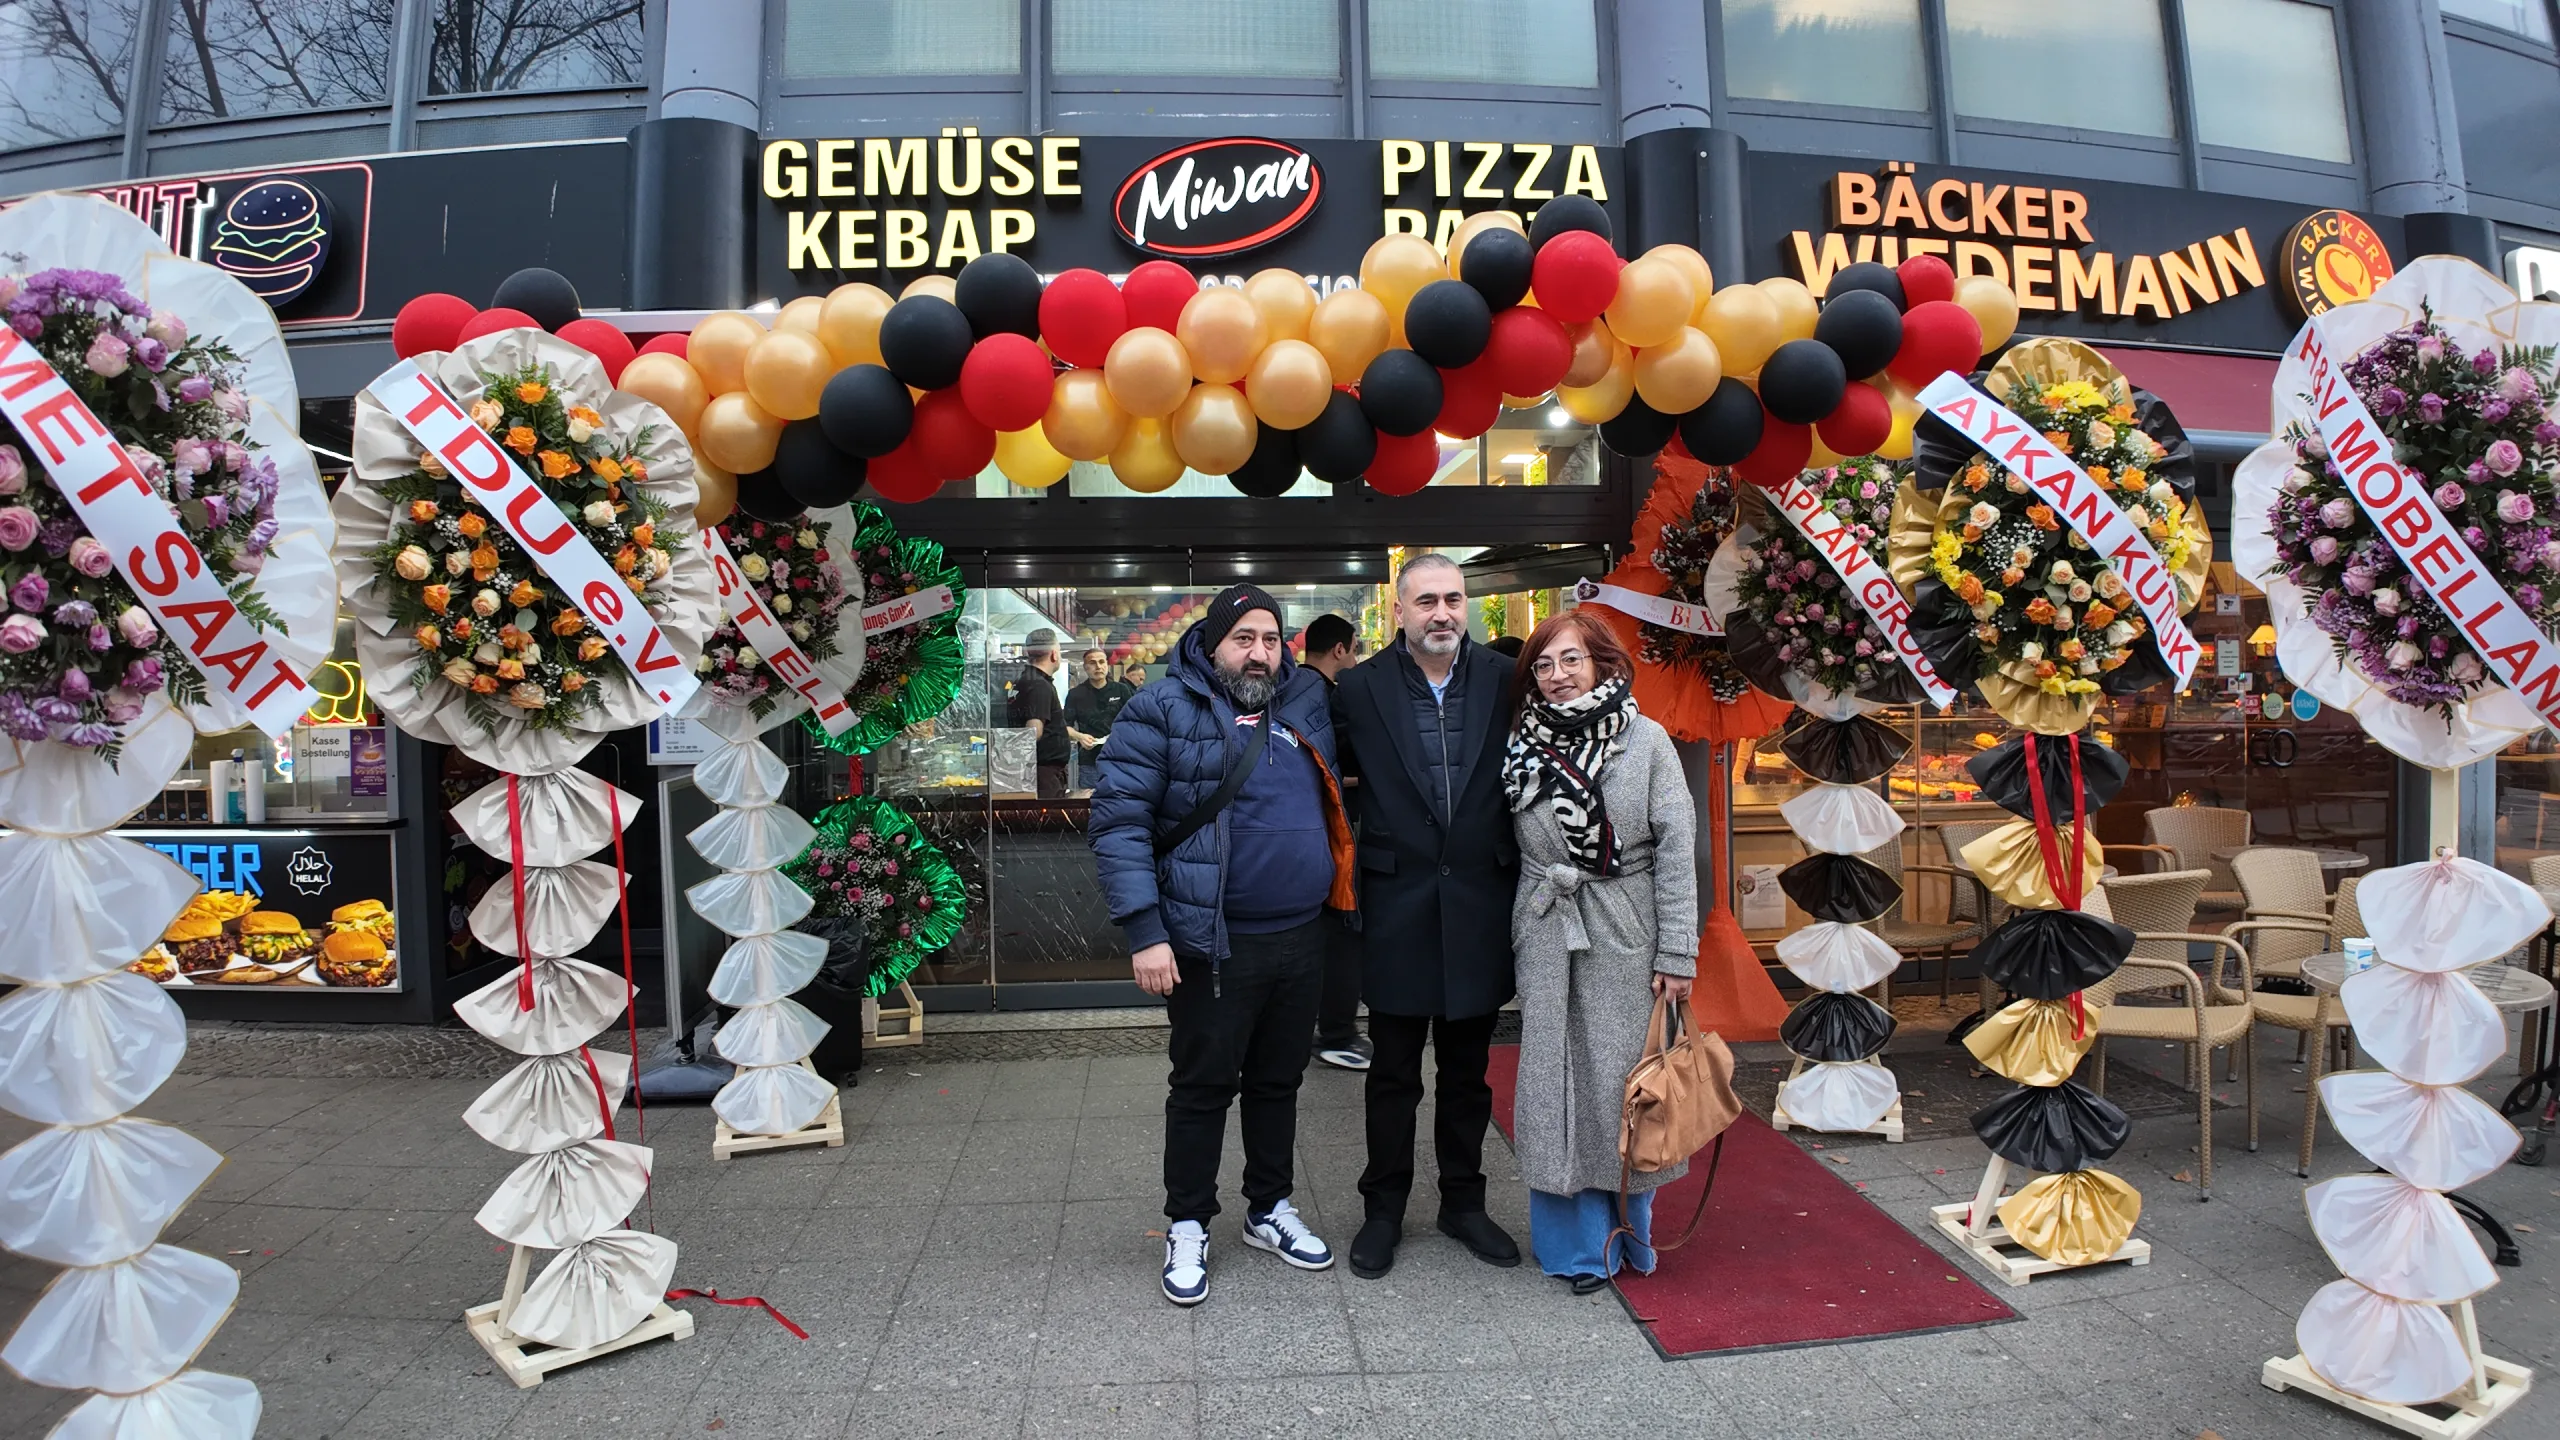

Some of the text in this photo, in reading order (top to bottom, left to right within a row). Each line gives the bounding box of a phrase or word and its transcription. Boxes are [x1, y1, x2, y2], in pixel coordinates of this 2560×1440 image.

[763, 127, 1082, 199] GEMÜSE
[1382, 139, 1609, 201] PIZZA
[1134, 153, 1311, 246] Miwan
[1836, 161, 2095, 244] BÄCKER
[786, 209, 1036, 270] KEBAP
[2300, 218, 2380, 263] BÄCKER
[405, 373, 682, 704] TDU e.V.
[1767, 479, 1871, 577] APLAN
[1937, 396, 2196, 676] AYKAN KÜTÜK
[2299, 326, 2560, 731] H&V MÖBELLAN
[703, 528, 772, 627] ST
[129, 530, 306, 712] SAAT
[301, 748, 350, 759] Bestellung
[311, 737, 340, 745] Kasse
[145, 842, 265, 898] GER
[294, 856, 325, 872] حلال
[295, 874, 326, 883] HELAL
